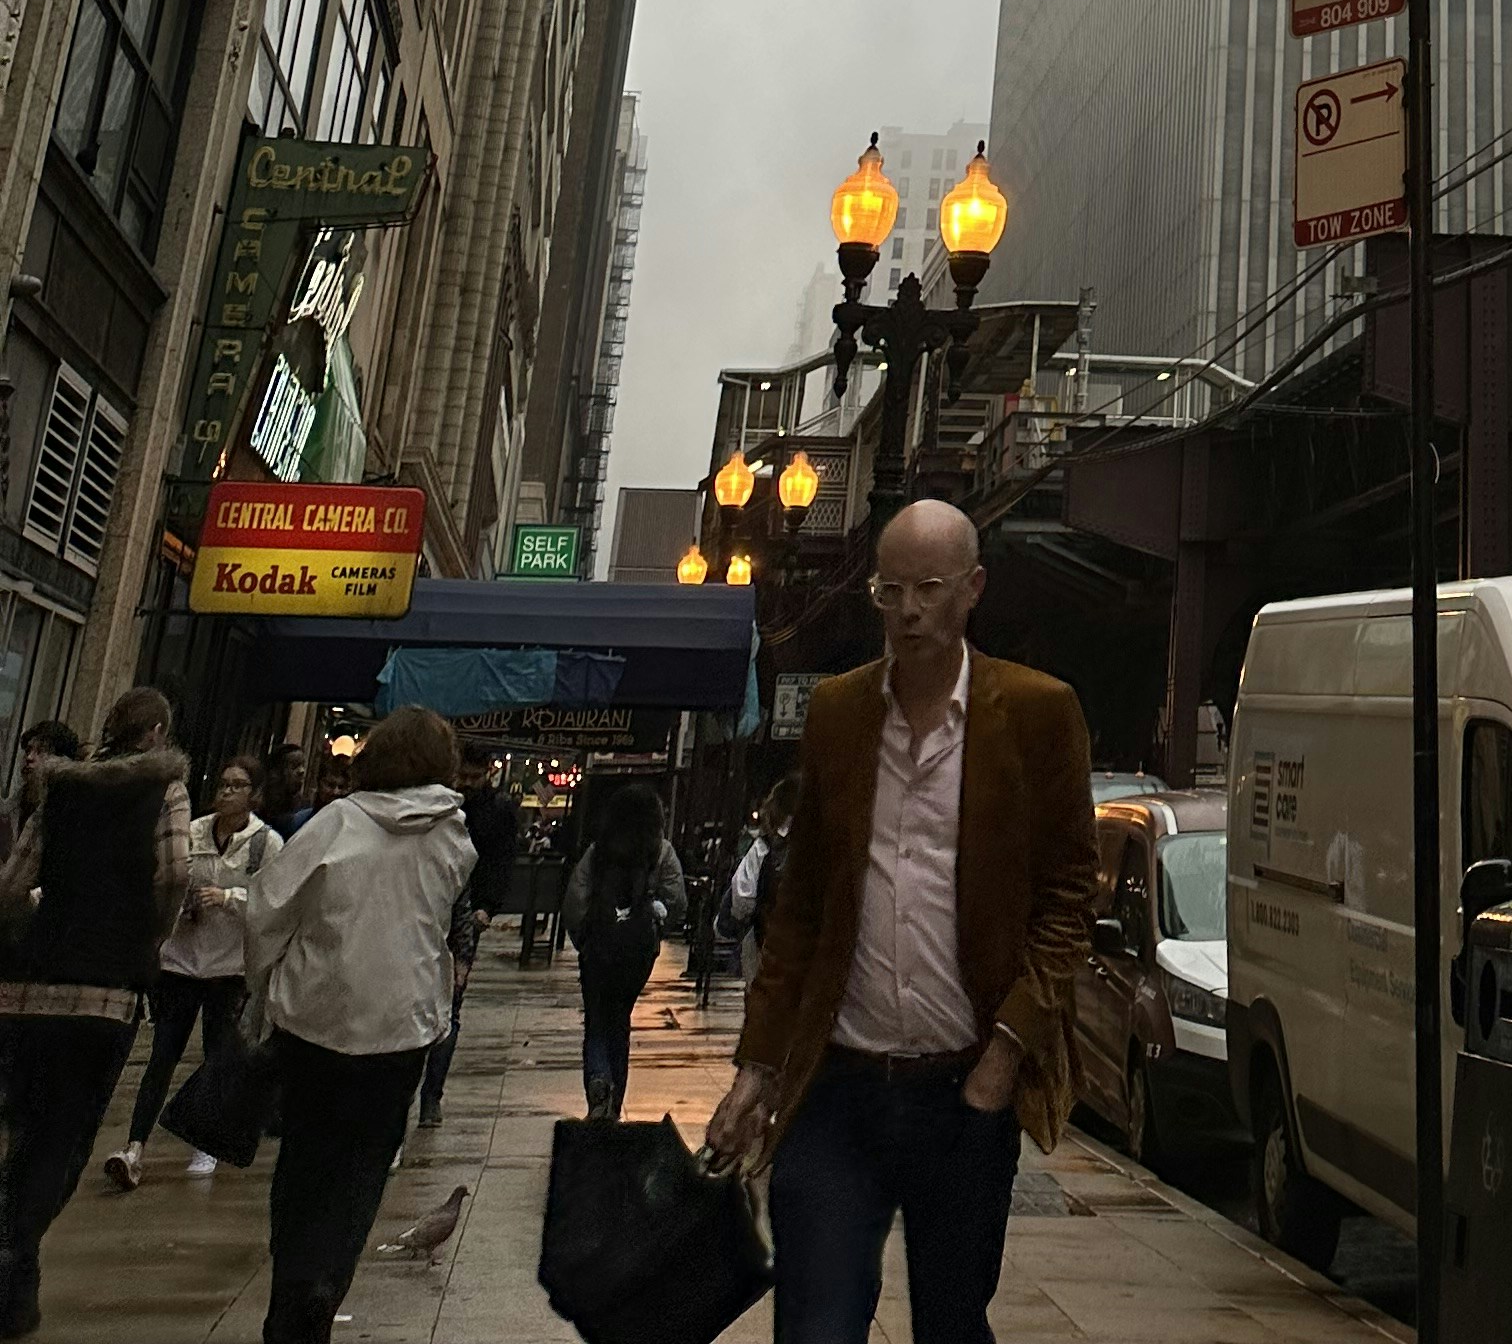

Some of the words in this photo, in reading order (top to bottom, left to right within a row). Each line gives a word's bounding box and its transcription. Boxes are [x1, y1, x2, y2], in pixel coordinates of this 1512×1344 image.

[1320, 0, 1353, 28] 804
[247, 146, 413, 196] Central
[1308, 216, 1343, 242] TOW
[1350, 203, 1395, 233] ZONE
[216, 501, 294, 532] CENTRAL
[302, 504, 375, 534] CAMERA
[382, 508, 410, 535] CO.
[521, 534, 569, 553] SELF
[330, 566, 396, 581] CAMERAS
[520, 552, 568, 571] PARK
[211, 562, 318, 596] Kodak
[344, 583, 377, 597] FILM
[576, 734, 607, 746] Since
[1277, 754, 1305, 789] smart
[1275, 791, 1298, 823] care
